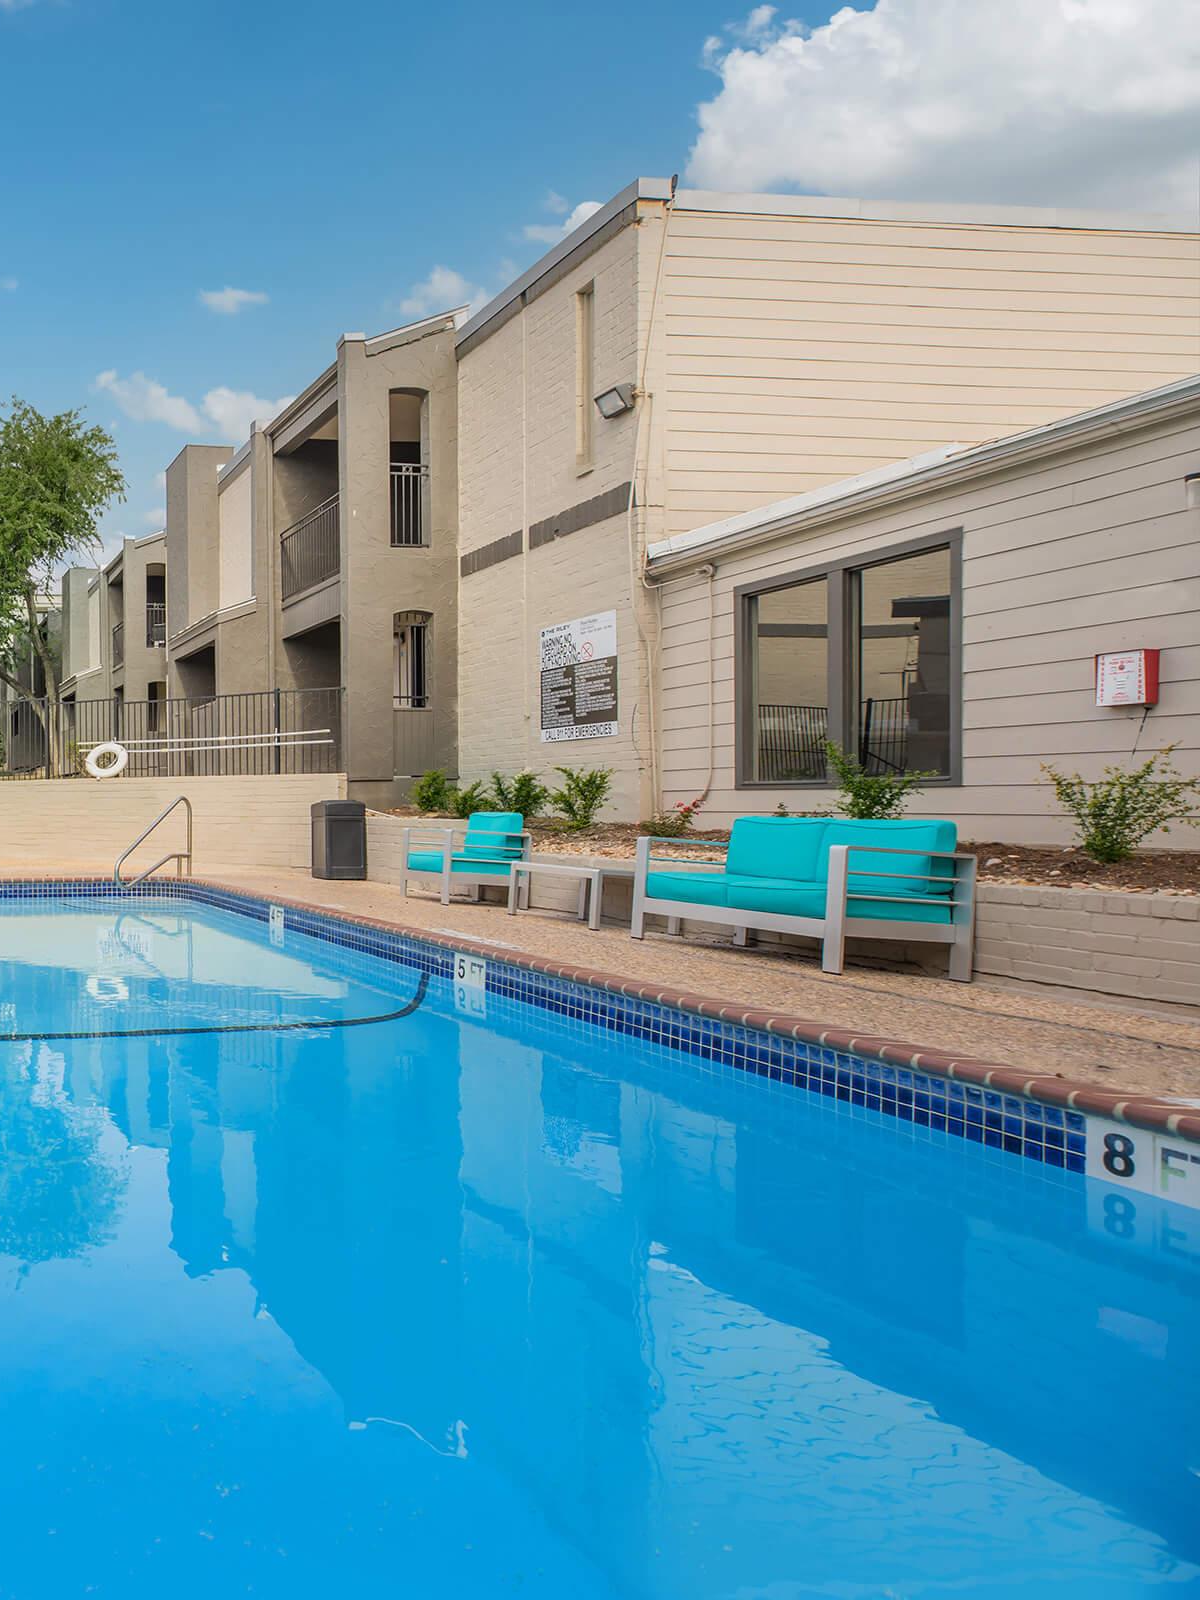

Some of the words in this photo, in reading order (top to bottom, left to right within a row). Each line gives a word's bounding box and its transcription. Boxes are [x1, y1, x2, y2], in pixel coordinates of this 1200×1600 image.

[564, 632, 573, 644] NO
[568, 642, 577, 654] ON
[565, 726, 575, 738] FOR
[458, 958, 466, 980] 5
[1103, 1132, 1136, 1178] 8
[1161, 1146, 1200, 1193] F
